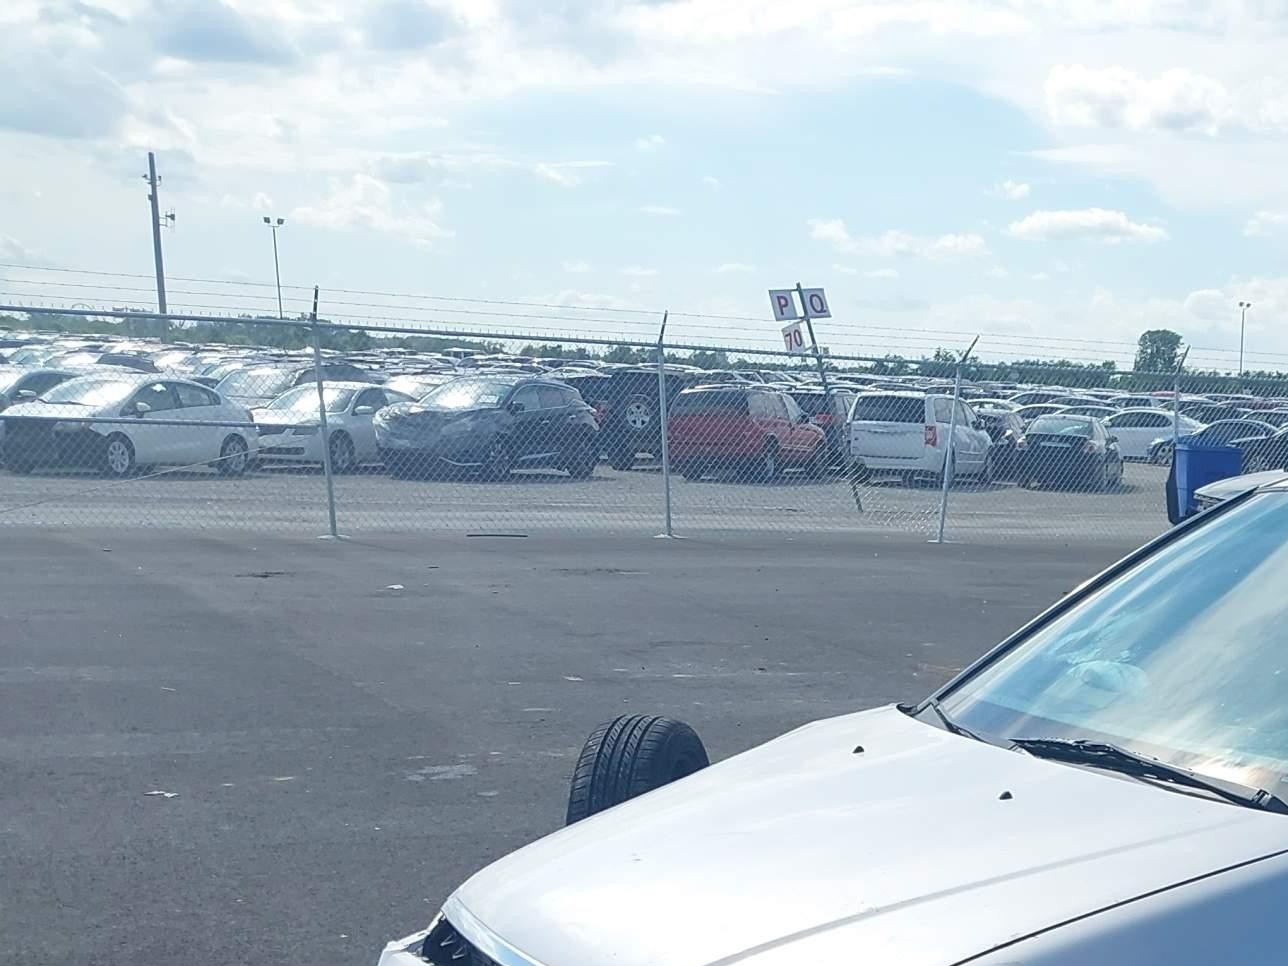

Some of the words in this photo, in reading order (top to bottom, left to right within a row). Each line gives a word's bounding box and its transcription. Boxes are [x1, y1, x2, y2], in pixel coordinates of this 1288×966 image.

[776, 295, 789, 316] P
[809, 293, 827, 314] Q
[784, 329, 803, 351] 70
